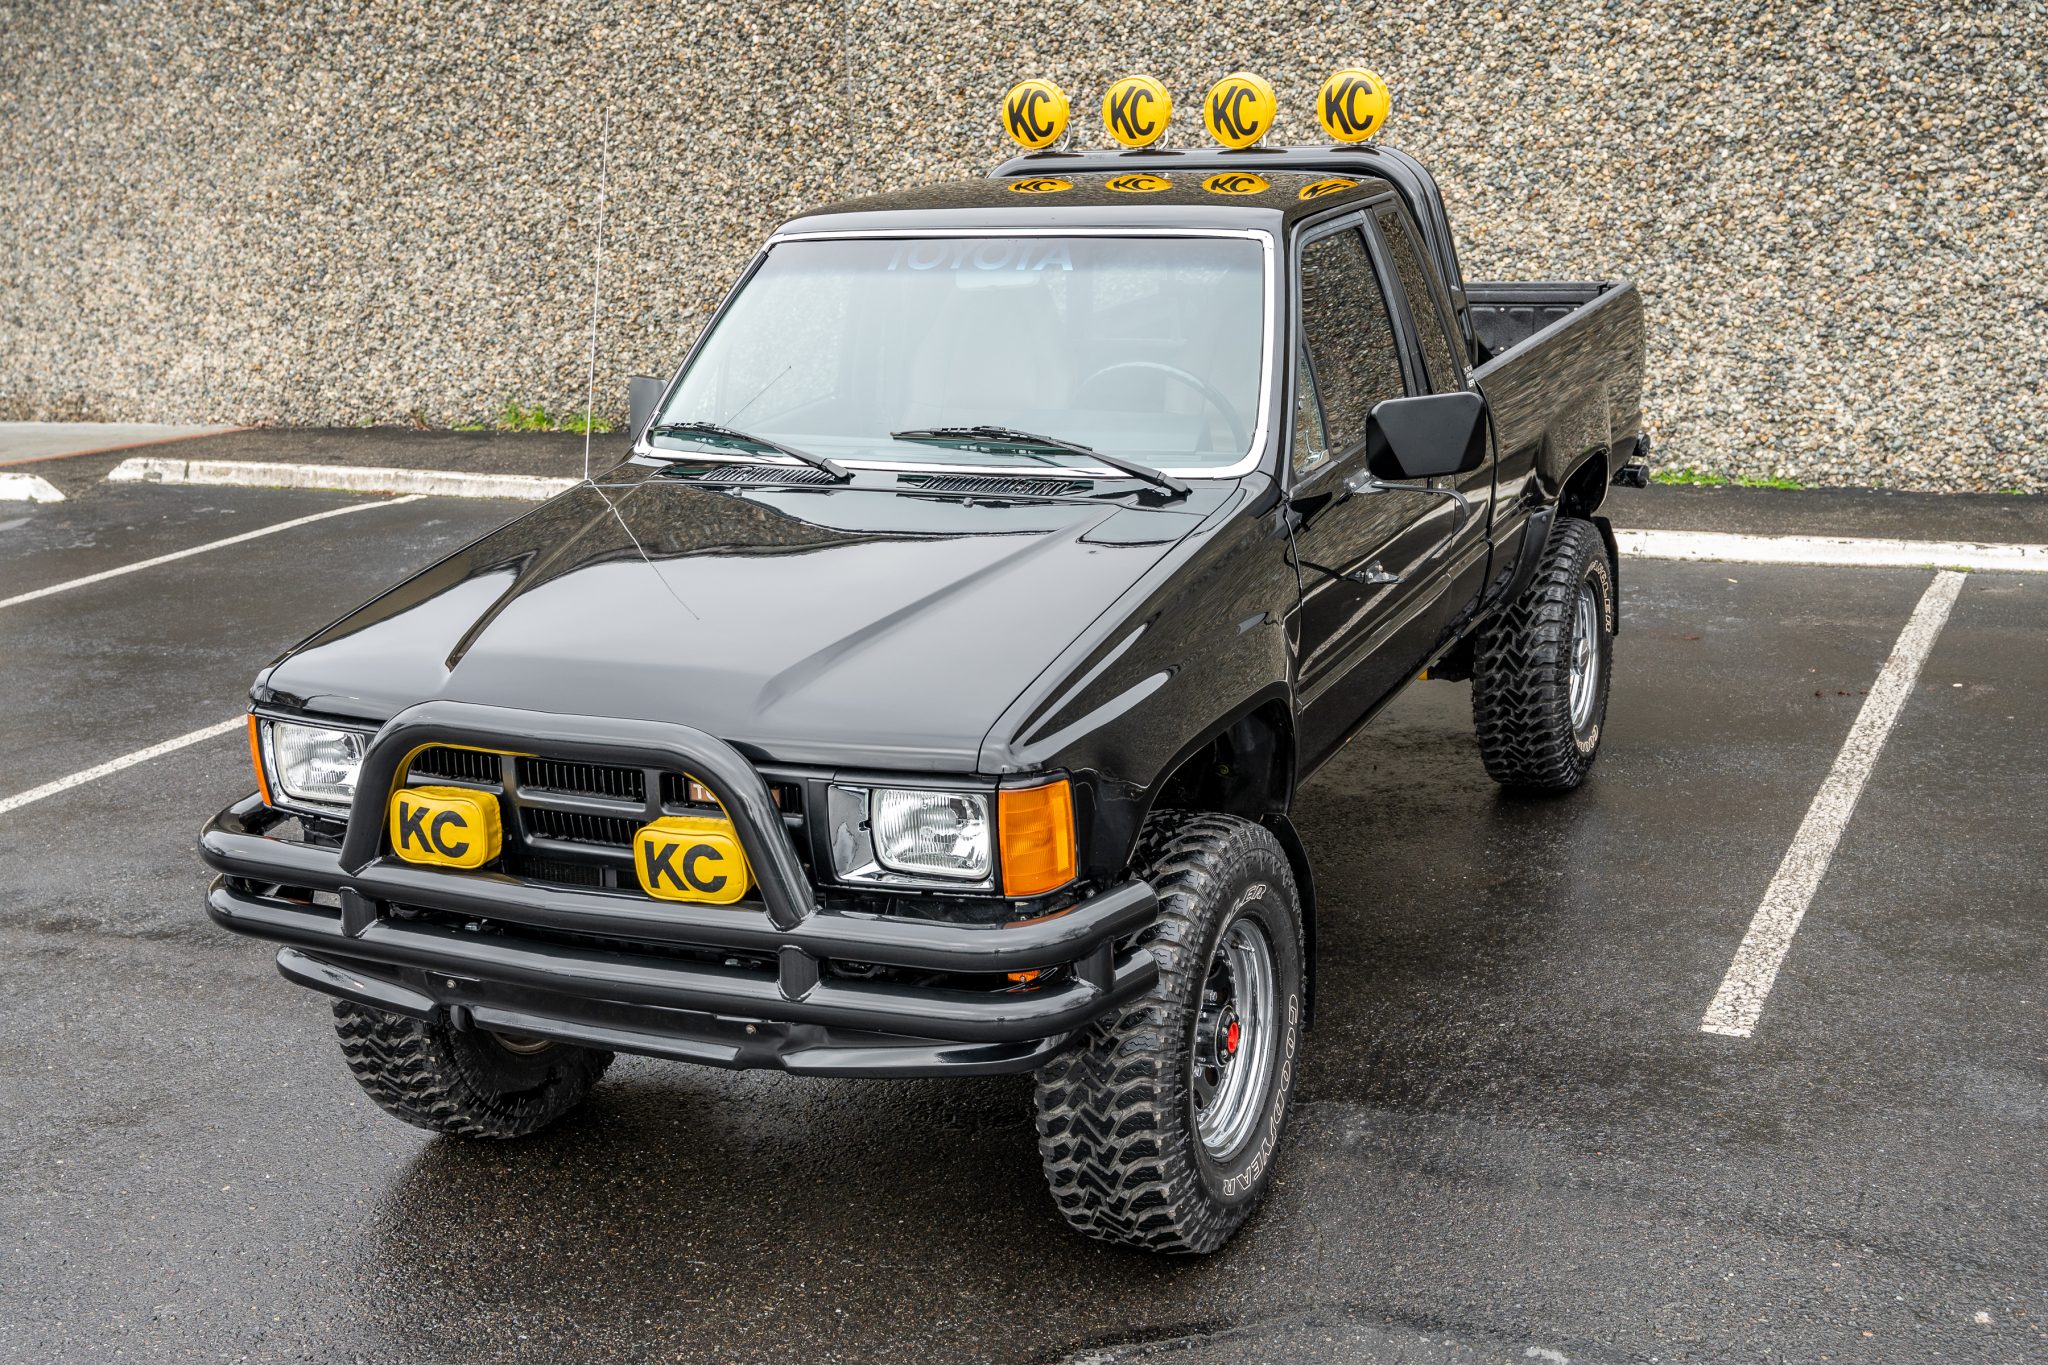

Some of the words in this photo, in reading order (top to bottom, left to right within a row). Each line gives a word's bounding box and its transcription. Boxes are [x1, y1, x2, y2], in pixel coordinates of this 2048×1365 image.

[1008, 88, 1054, 142] KC
[1111, 86, 1155, 139] KC
[1212, 85, 1258, 140] KC
[1325, 77, 1373, 135] KC
[888, 238, 1073, 271] TOYOTA
[400, 801, 470, 858] KC
[644, 840, 727, 893] KC
[1223, 994, 1299, 1196] GOODYEAR
